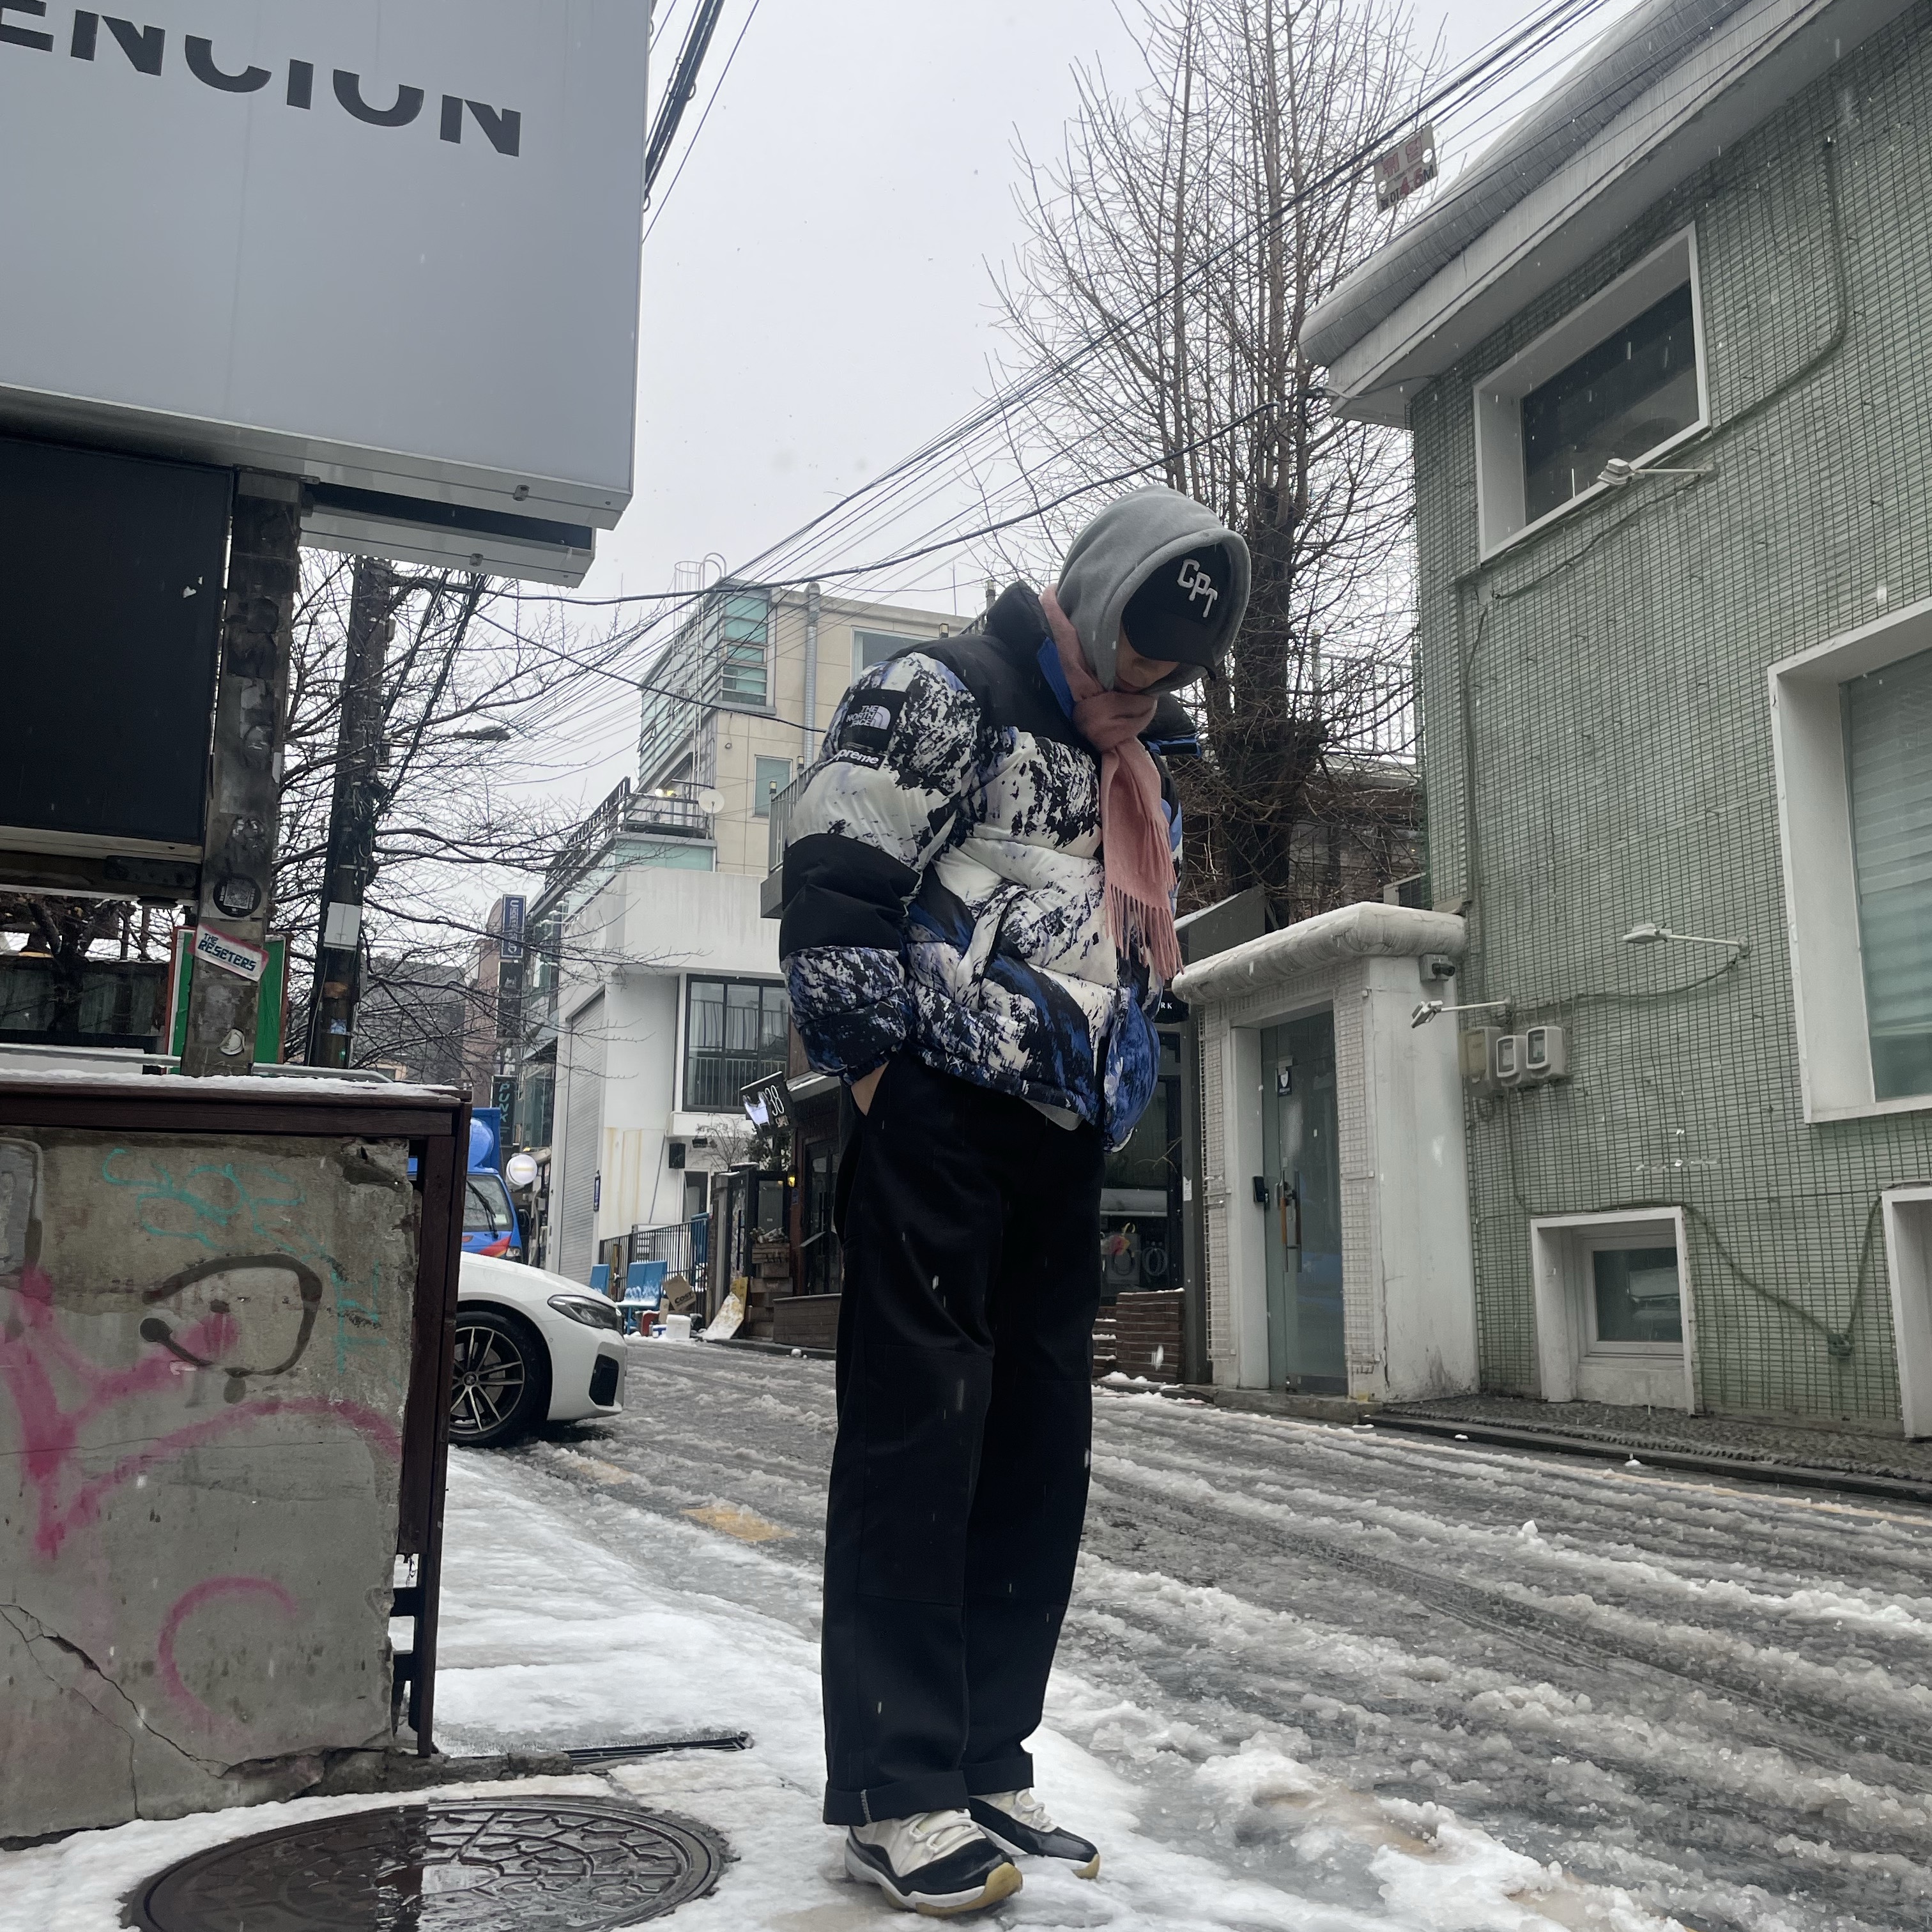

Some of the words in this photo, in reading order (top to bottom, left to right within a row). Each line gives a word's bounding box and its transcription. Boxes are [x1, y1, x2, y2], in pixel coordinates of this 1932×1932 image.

[1177, 558, 1218, 618] CPT
[846, 711, 875, 723] NORTH
[833, 749, 880, 764] preme
[202, 933, 219, 944] THE
[197, 939, 257, 972] RESETERS
[498, 1083, 510, 1123] PUNK
